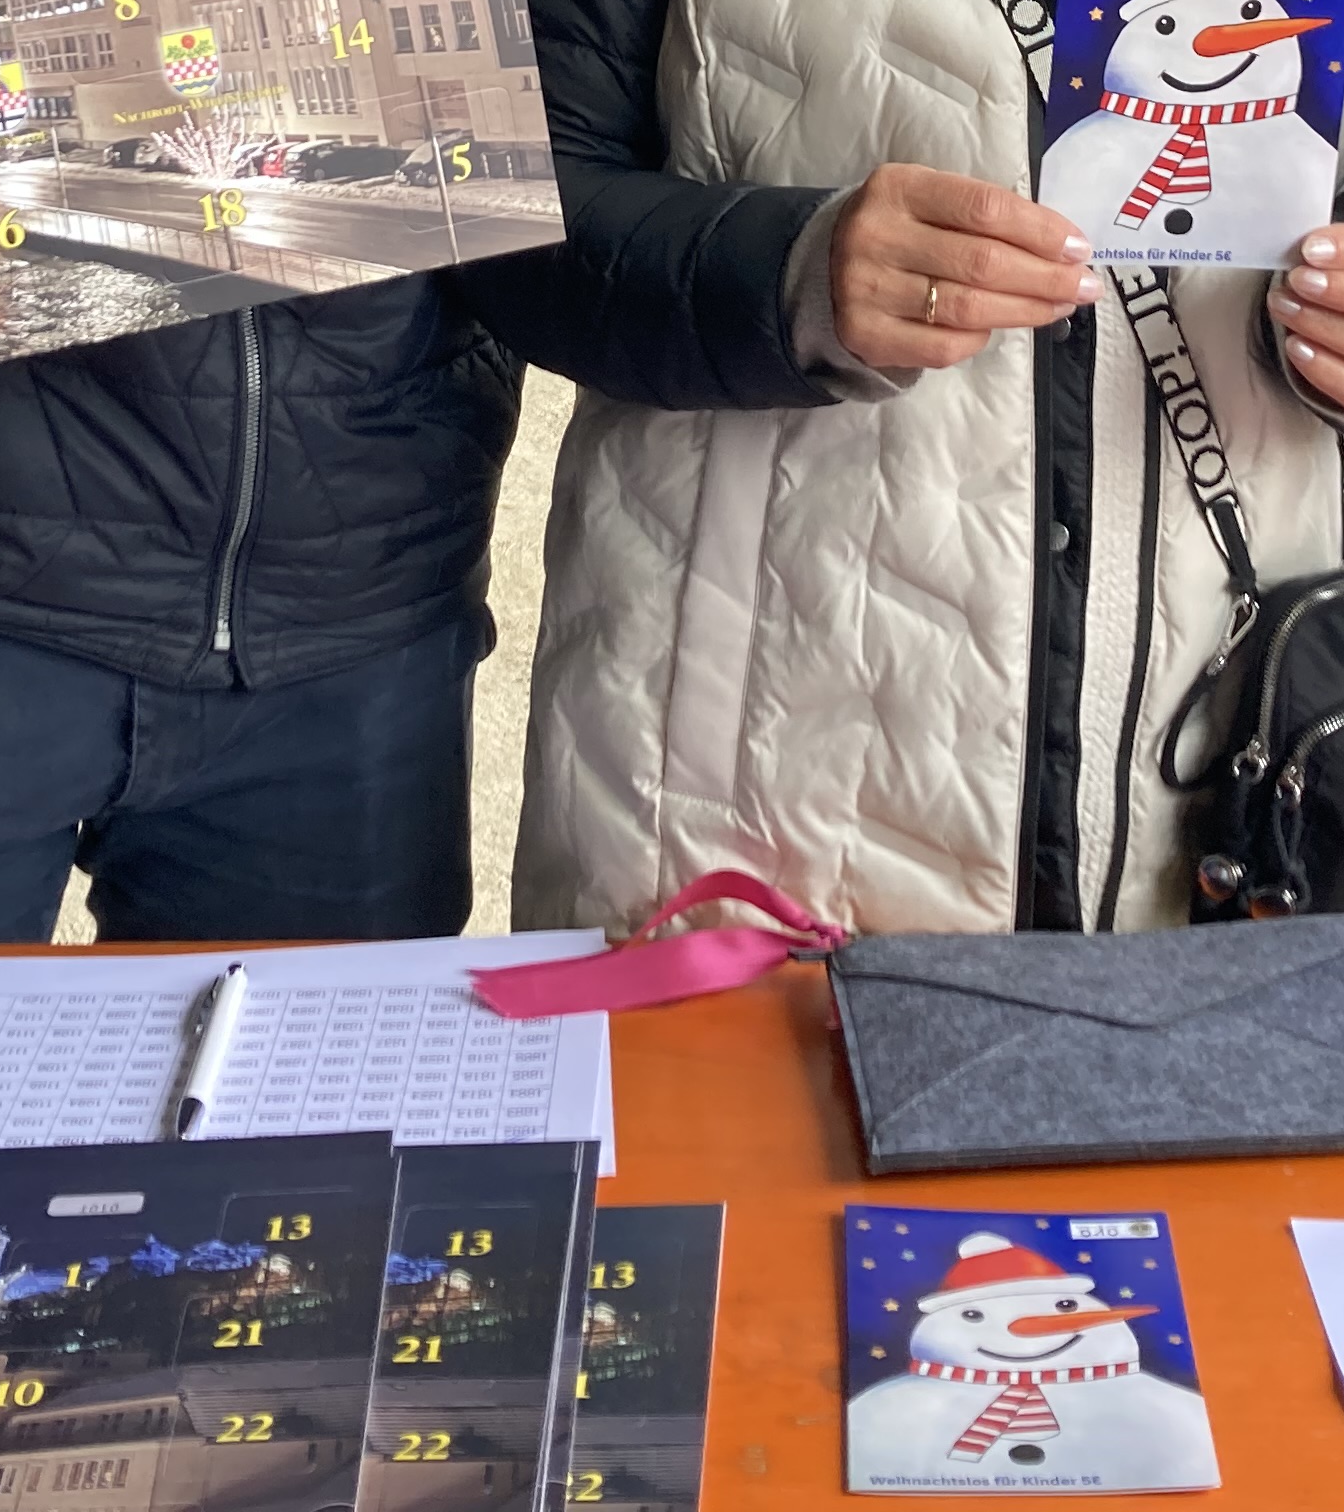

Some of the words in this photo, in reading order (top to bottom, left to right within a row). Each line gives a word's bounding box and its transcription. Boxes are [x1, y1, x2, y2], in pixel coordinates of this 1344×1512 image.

[328, 19, 375, 60] 14
[451, 142, 473, 182] 5
[201, 189, 247, 231] 18
[1147, 248, 1165, 260] für
[1169, 249, 1212, 261] Kinder
[1215, 250, 1232, 261] 5€
[1149, 344, 1240, 509] JOOP!
[266, 1214, 312, 1241] 13
[445, 1230, 493, 1257] 13
[65, 1264, 82, 1287] 1
[590, 1262, 636, 1288] 13
[213, 1321, 264, 1347] 21
[393, 1336, 442, 1363] 21
[216, 1415, 274, 1443] 22
[393, 1433, 451, 1461] 22
[869, 1476, 990, 1487] Weihnachtslos
[994, 1476, 1018, 1487] für
[1022, 1476, 1077, 1486] Kinder
[1081, 1476, 1103, 1486] 5€
